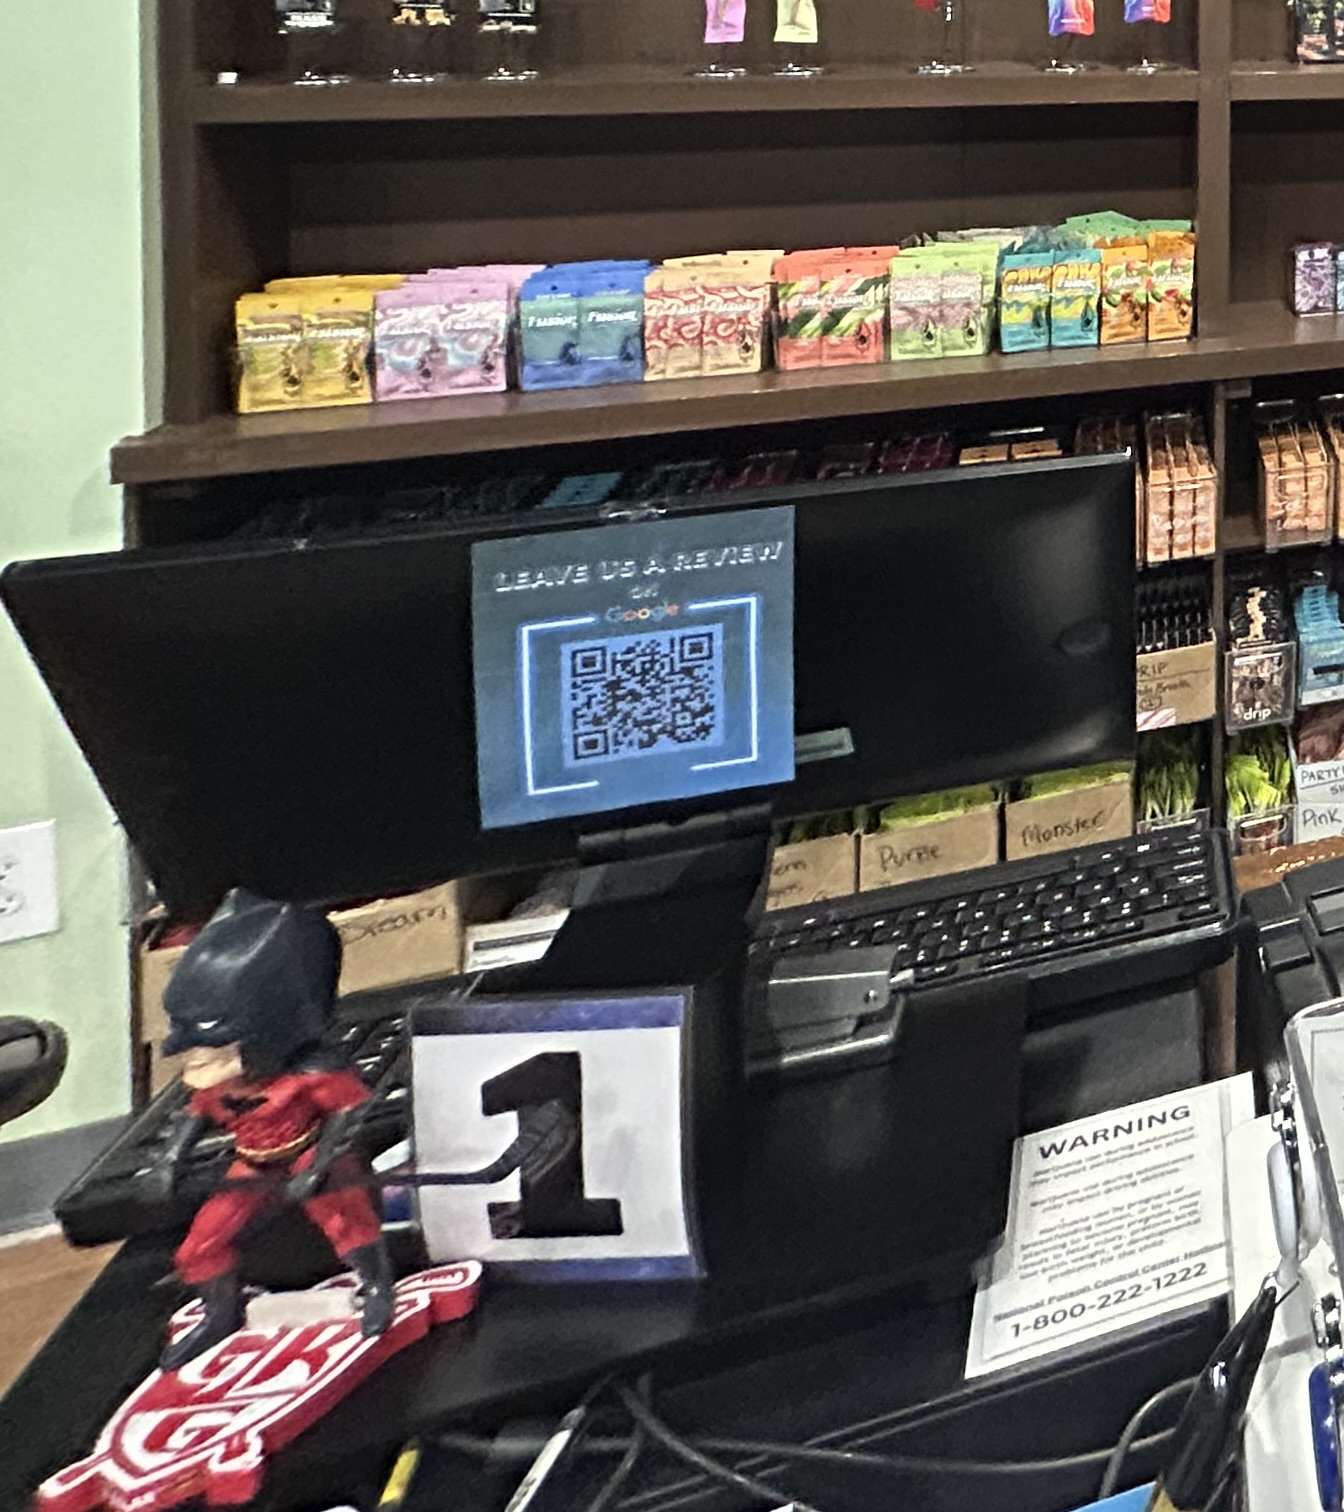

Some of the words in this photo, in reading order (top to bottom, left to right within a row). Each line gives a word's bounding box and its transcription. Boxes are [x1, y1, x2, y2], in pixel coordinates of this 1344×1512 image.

[496, 565, 589, 593] LEAVE
[601, 558, 634, 581] US
[642, 556, 666, 576] A
[673, 541, 784, 572] REVIEW
[605, 600, 679, 622] Google
[1137, 662, 1168, 678] RIP
[1243, 701, 1272, 721] drip
[1300, 765, 1340, 784] PARTY
[1021, 807, 1108, 847] Monster
[481, 1051, 624, 1240] 1
[1038, 1105, 1191, 1160] WARNING
[1010, 1262, 1208, 1339] 1-800-222-1222
